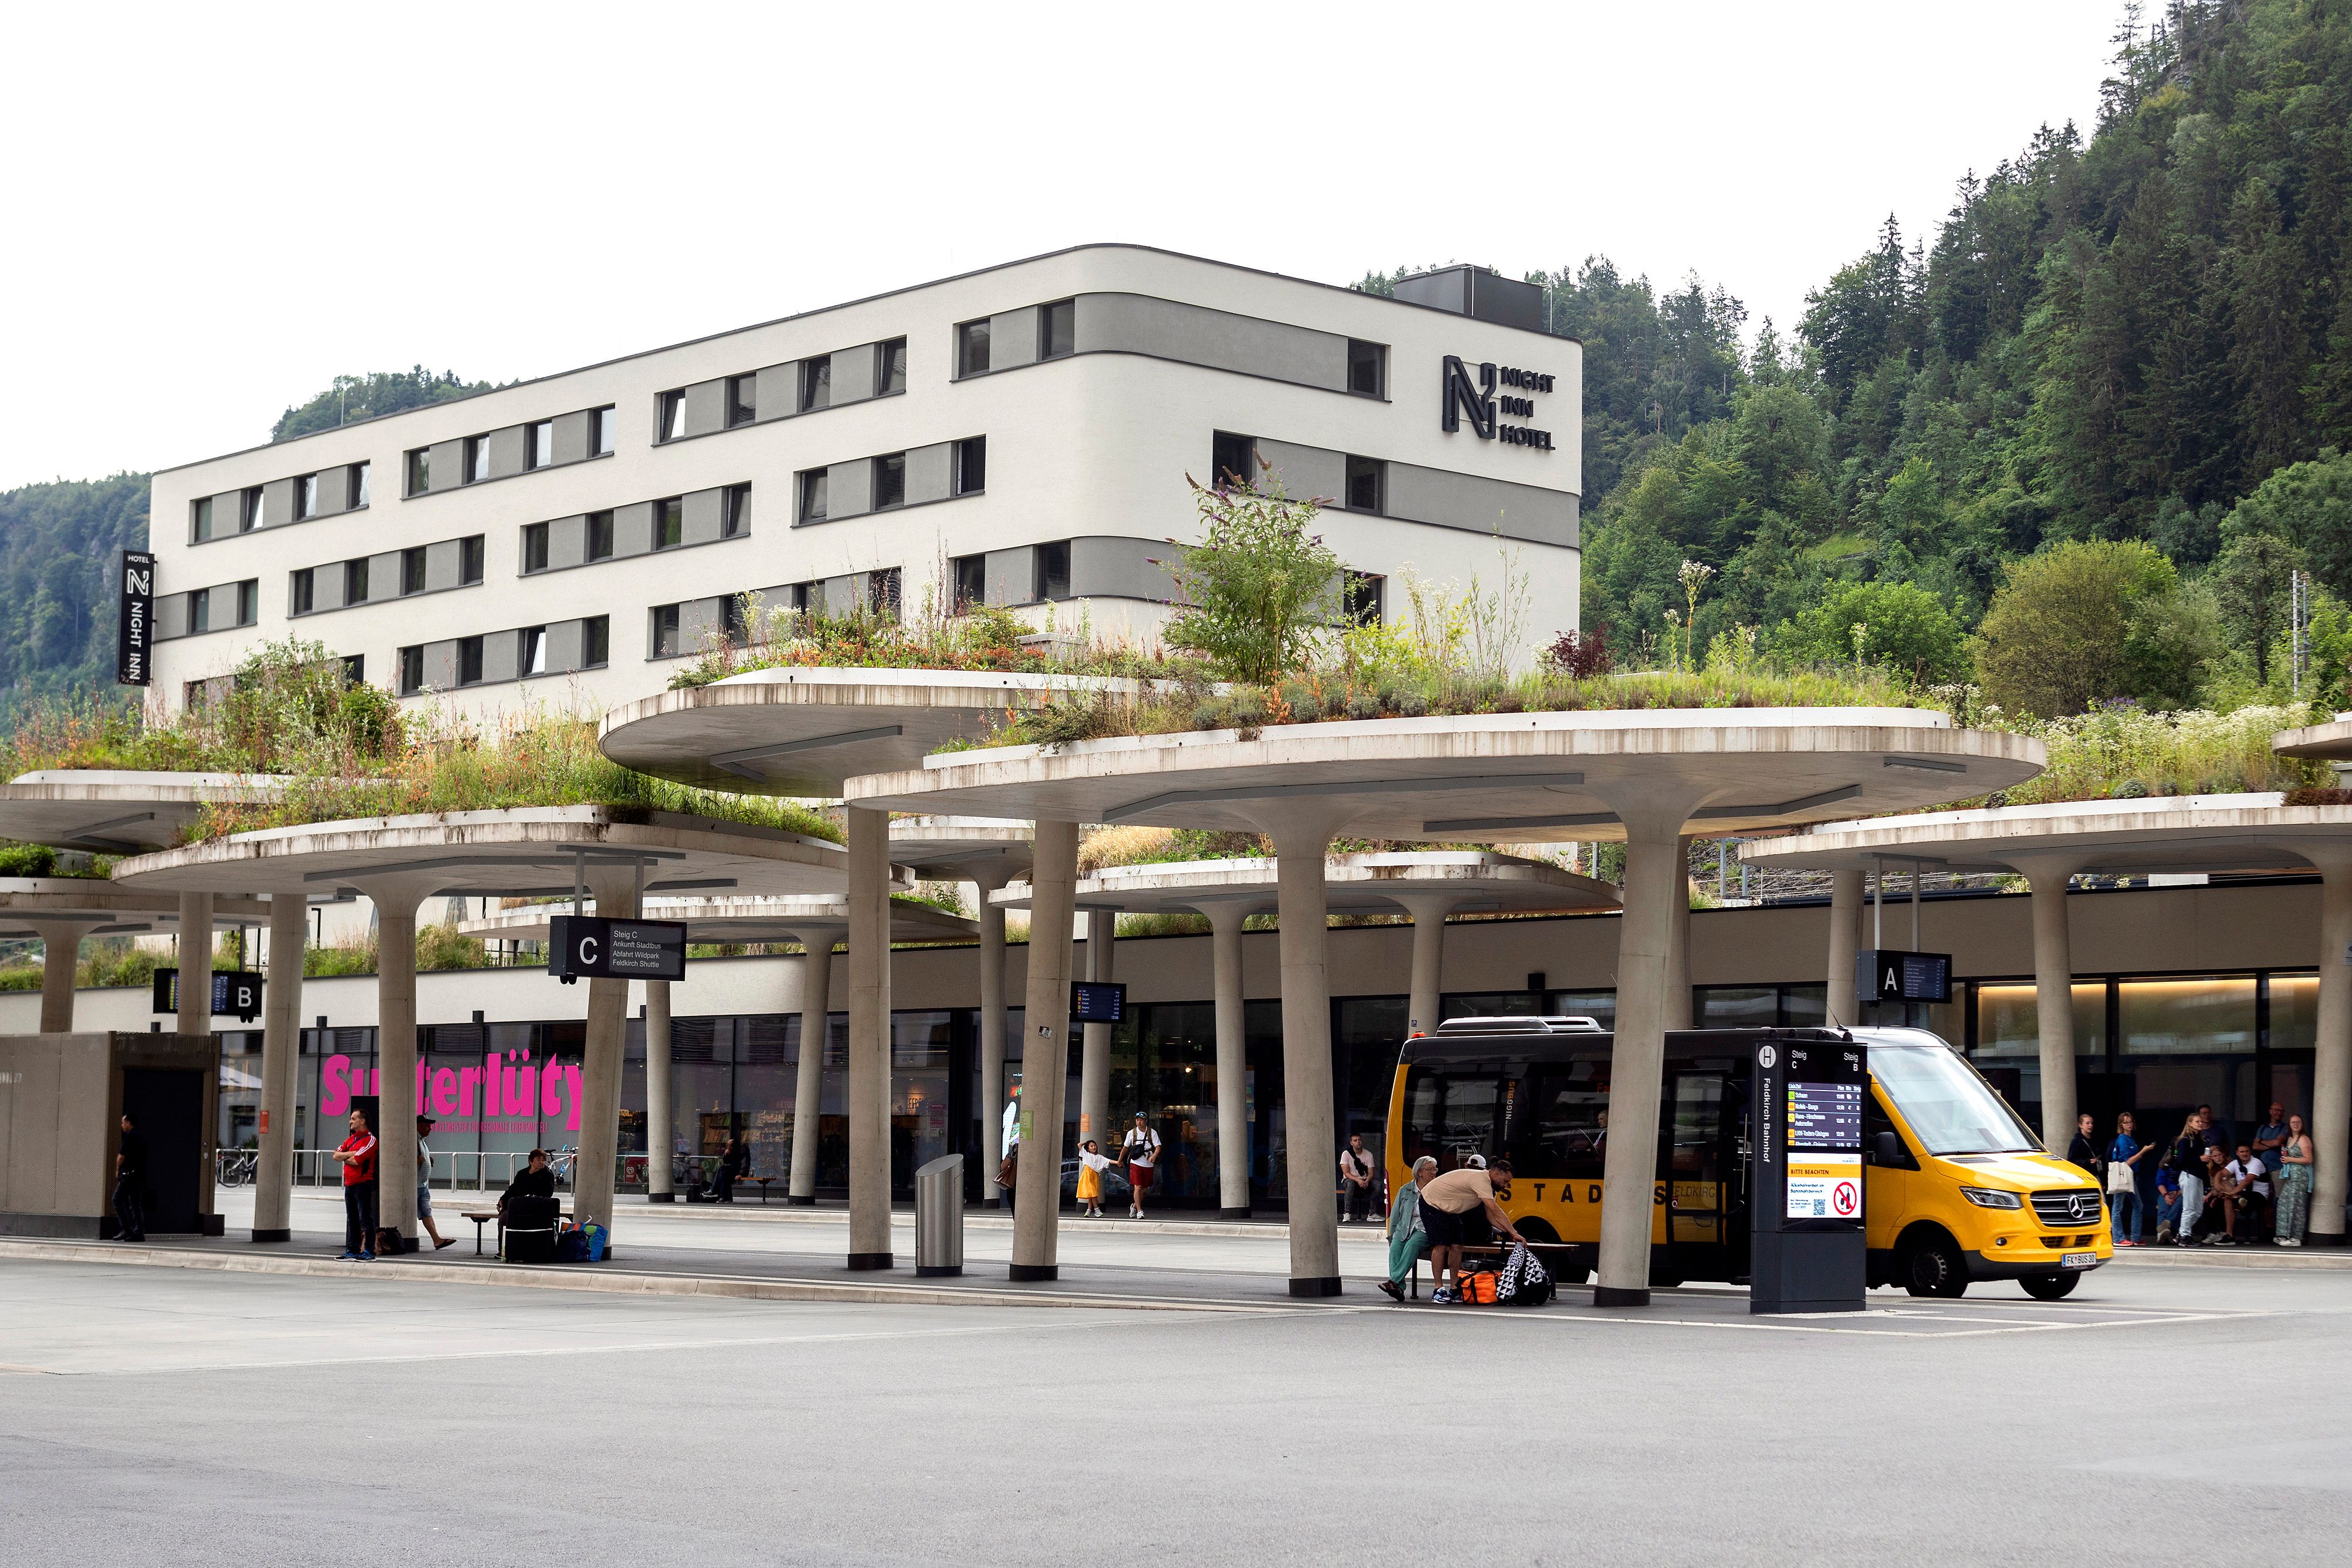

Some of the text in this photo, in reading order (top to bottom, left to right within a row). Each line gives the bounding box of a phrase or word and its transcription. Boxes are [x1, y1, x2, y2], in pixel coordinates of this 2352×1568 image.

[1501, 366, 1555, 393] NIGHT
[1501, 395, 1534, 417] INN
[1501, 424, 1555, 450] HOTEL
[128, 555, 149, 564] HOTEL
[129, 602, 143, 680] NIGHT INN
[614, 931, 630, 940] Steig
[579, 937, 598, 964] C
[1885, 968, 1897, 990] A
[238, 987, 252, 1007] B
[1792, 1050, 1806, 1060] Steig
[1792, 1061, 1797, 1069] C
[1844, 1052, 1858, 1062] Steig
[1505, 1081, 1515, 1119] NIGGBUS
[435, 1121, 468, 1133] WELTMEISTER
[470, 1120, 479, 1133] FÜR
[481, 1121, 508, 1133] REGIONALE
[510, 1121, 548, 1133] LEBENSMITEL!
[2067, 1256, 2074, 1264] FK
